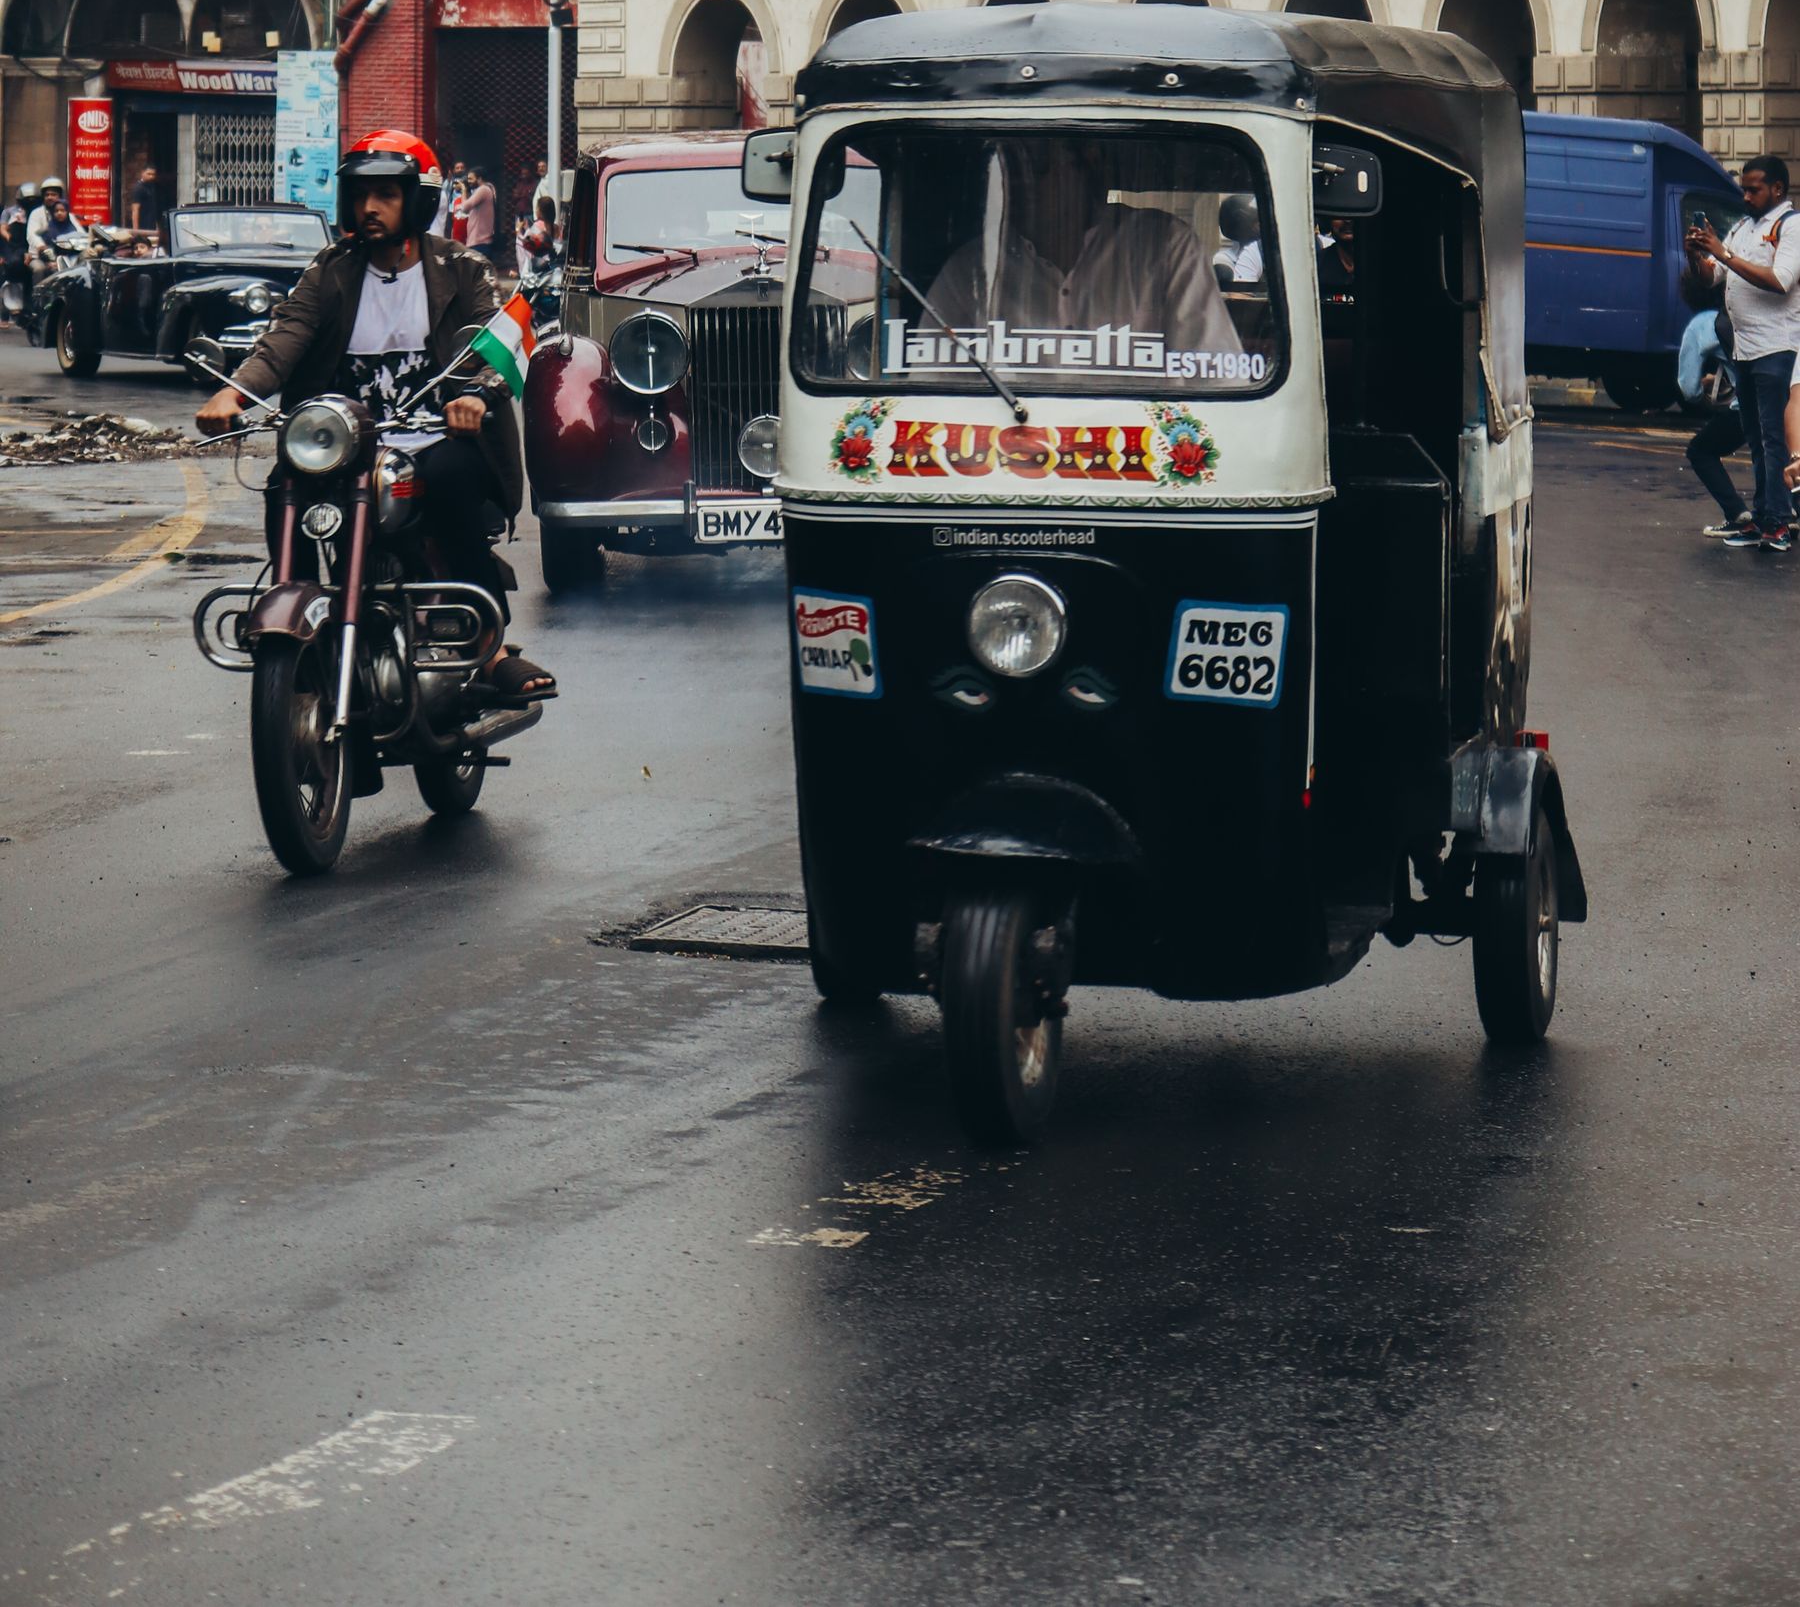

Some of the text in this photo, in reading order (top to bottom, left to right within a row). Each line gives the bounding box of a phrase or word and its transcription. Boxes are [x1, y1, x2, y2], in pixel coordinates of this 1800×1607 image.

[178, 71, 234, 90] Wood
[1167, 350, 1265, 380] EST.1980
[887, 421, 1159, 482] KUSHI
[704, 510, 761, 537] BMY
[953, 527, 1095, 545] indian.scooterhead
[1178, 654, 1275, 695] 6682
